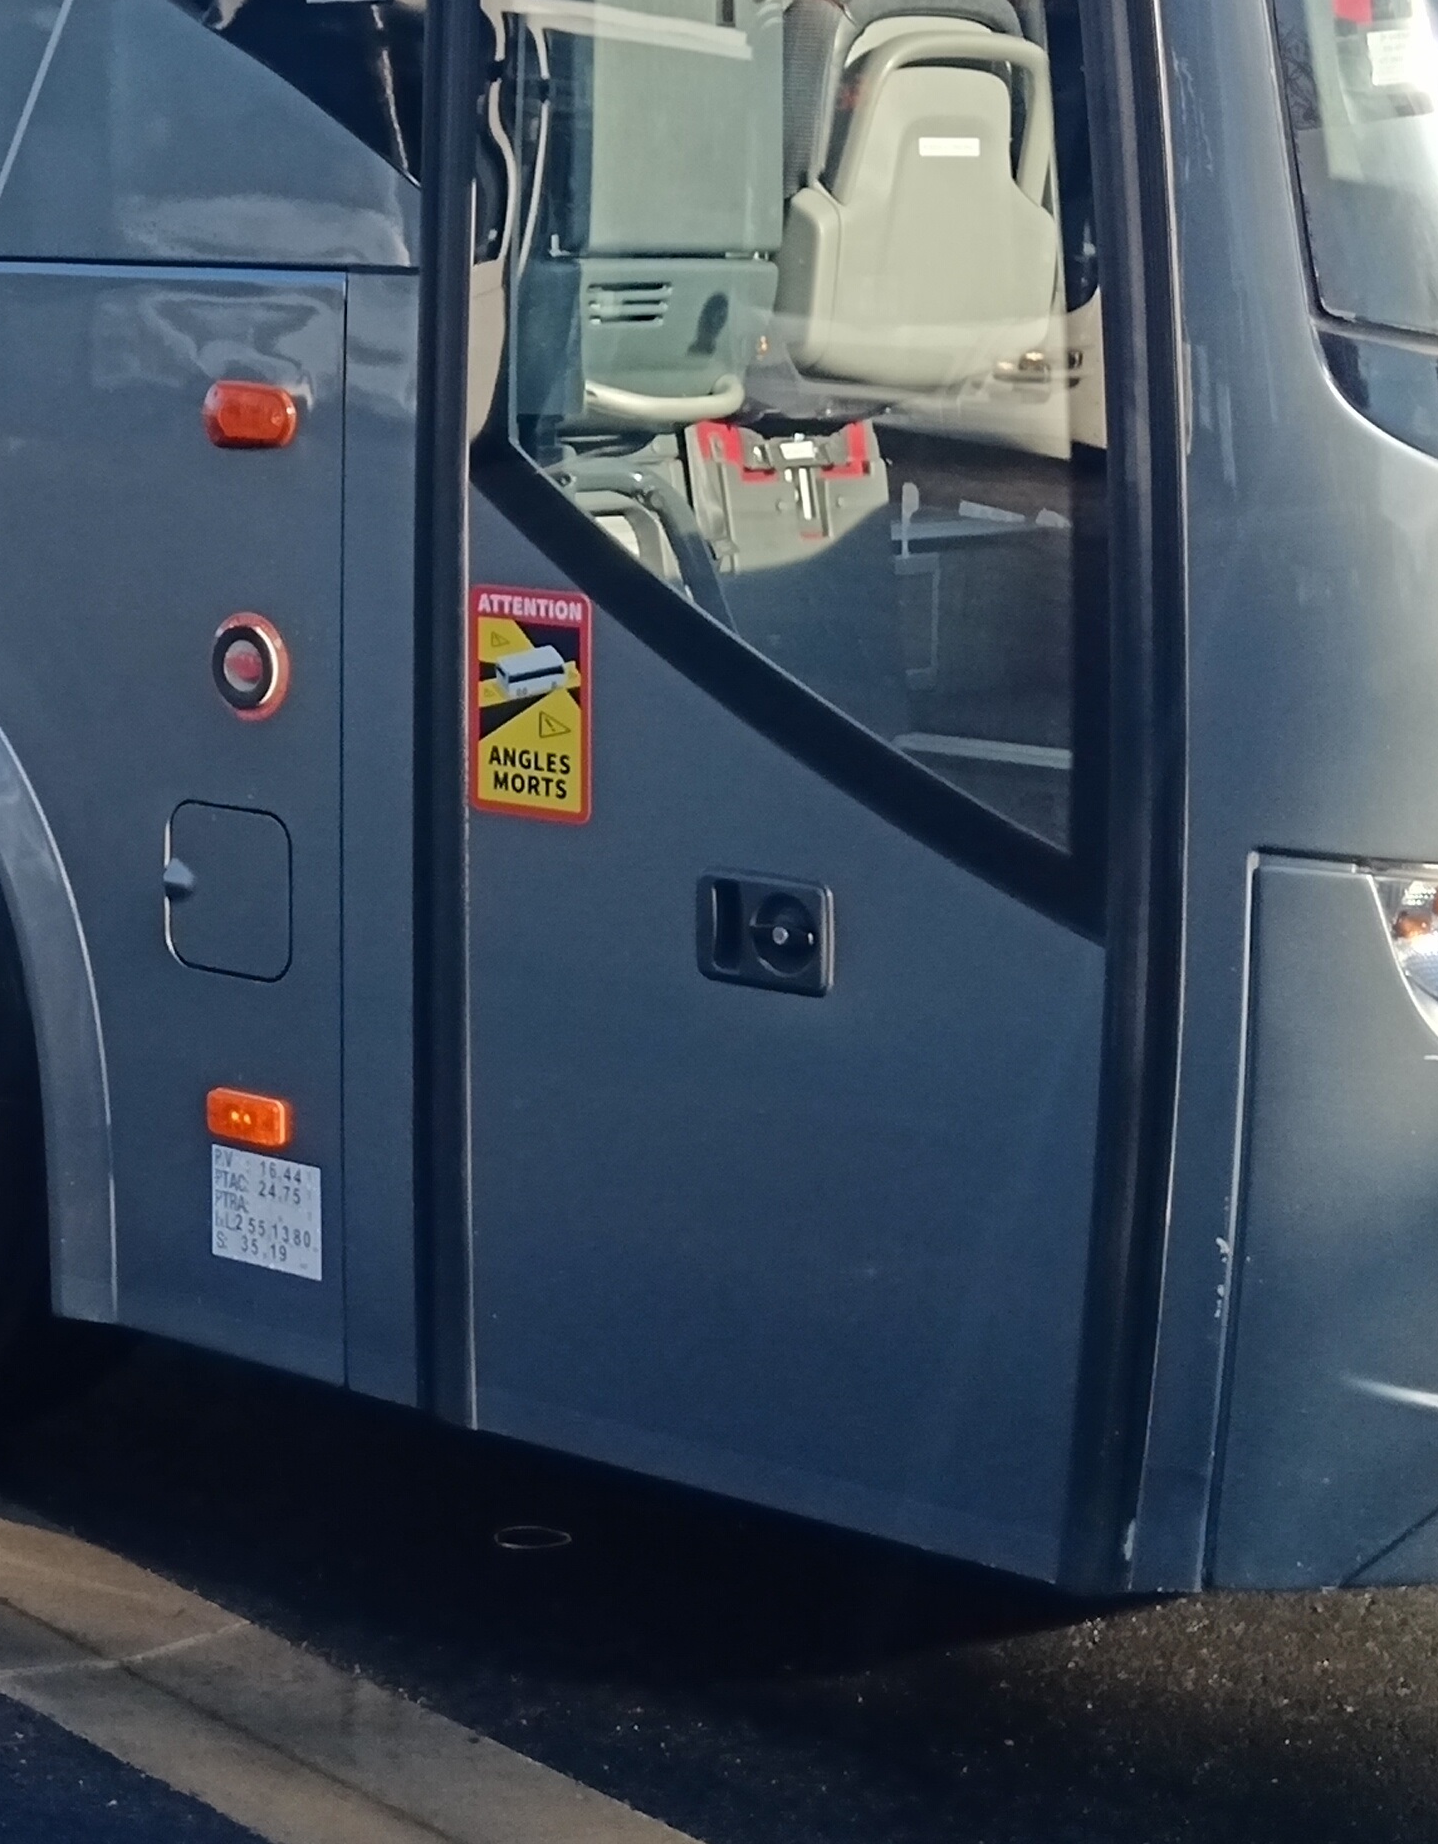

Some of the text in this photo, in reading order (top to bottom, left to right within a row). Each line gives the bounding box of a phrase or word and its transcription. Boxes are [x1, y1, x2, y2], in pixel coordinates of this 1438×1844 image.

[477, 592, 583, 621] ATTENTION
[489, 745, 571, 775] ANGLES
[493, 771, 568, 799] MORTS
